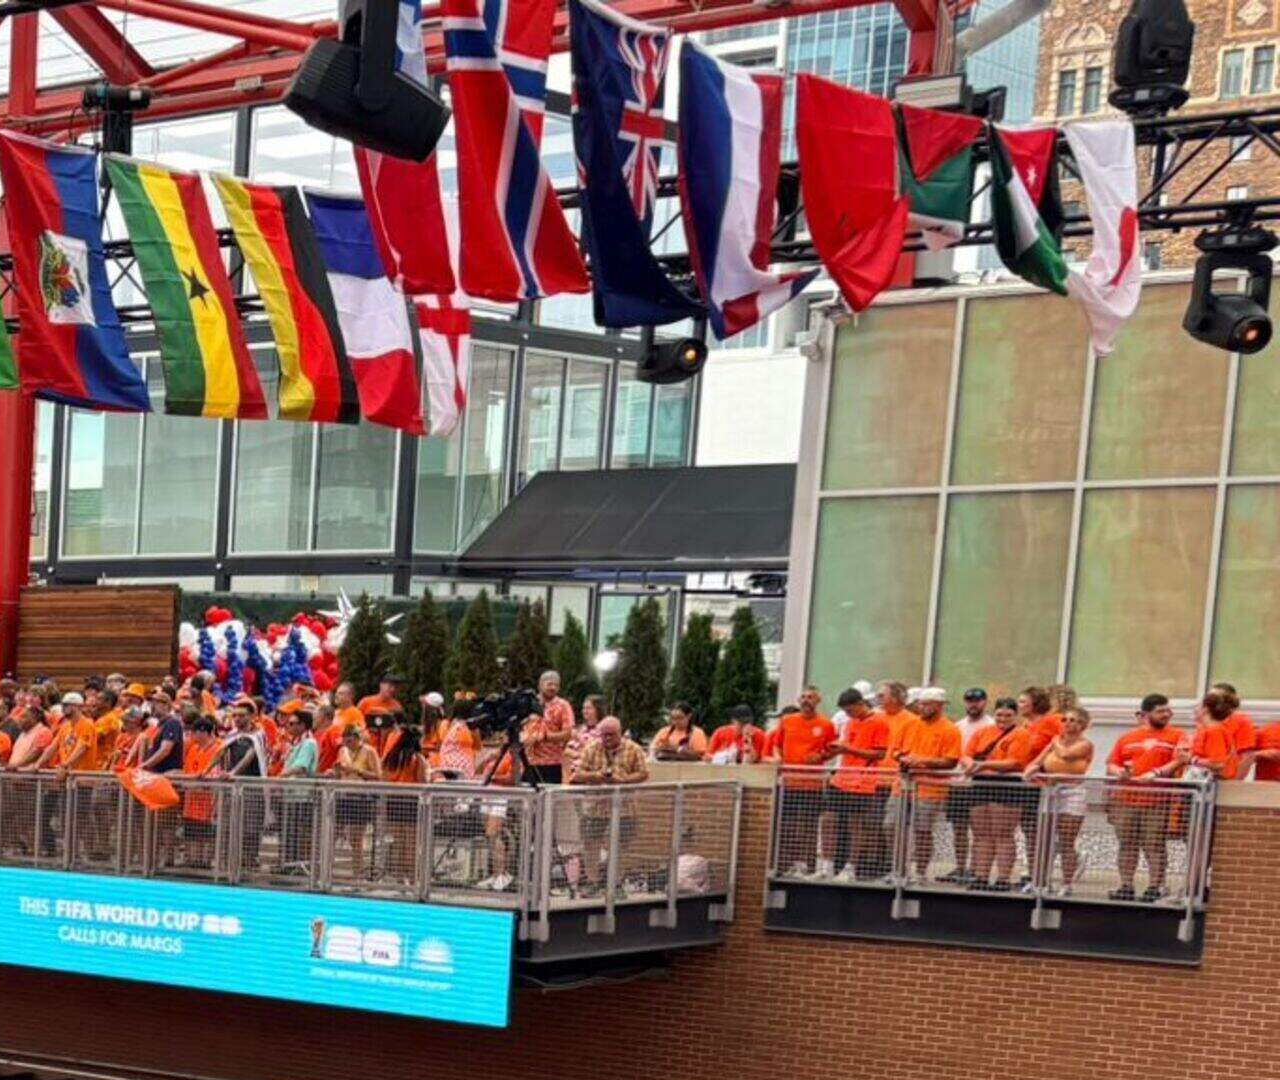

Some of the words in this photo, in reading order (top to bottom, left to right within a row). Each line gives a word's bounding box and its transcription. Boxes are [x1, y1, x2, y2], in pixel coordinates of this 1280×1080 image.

[19, 896, 50, 916] THIS
[55, 899, 91, 920] FIFA
[95, 903, 160, 928] WORLD
[162, 910, 201, 932] CUP
[58, 926, 98, 945] CALLS
[100, 929, 129, 947] FOR
